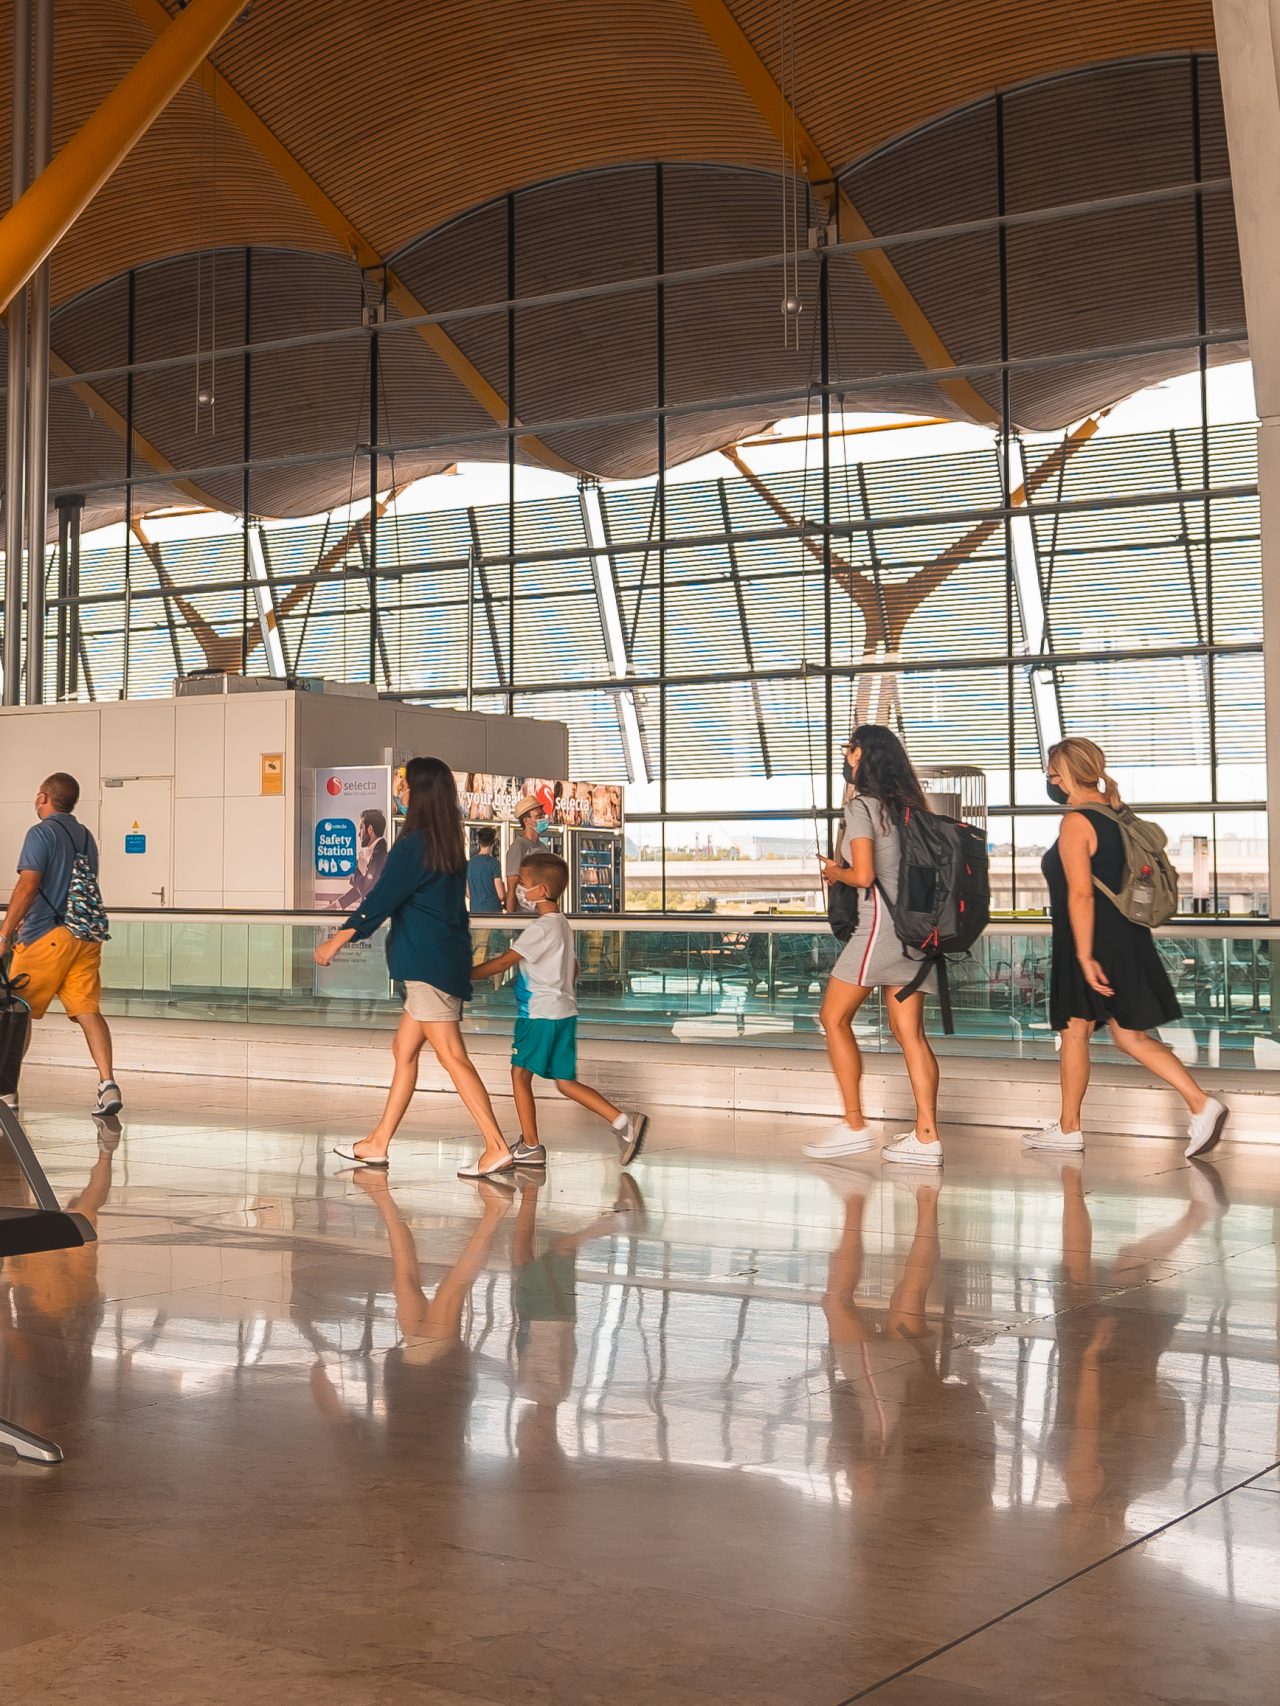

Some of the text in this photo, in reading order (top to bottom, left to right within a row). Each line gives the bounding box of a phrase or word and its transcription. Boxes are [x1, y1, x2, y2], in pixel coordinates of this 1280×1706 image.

[343, 781, 377, 791] selecta
[467, 791, 493, 807] your
[555, 797, 590, 811] selecta
[319, 834, 352, 848] Safety
[317, 846, 354, 856] Station
